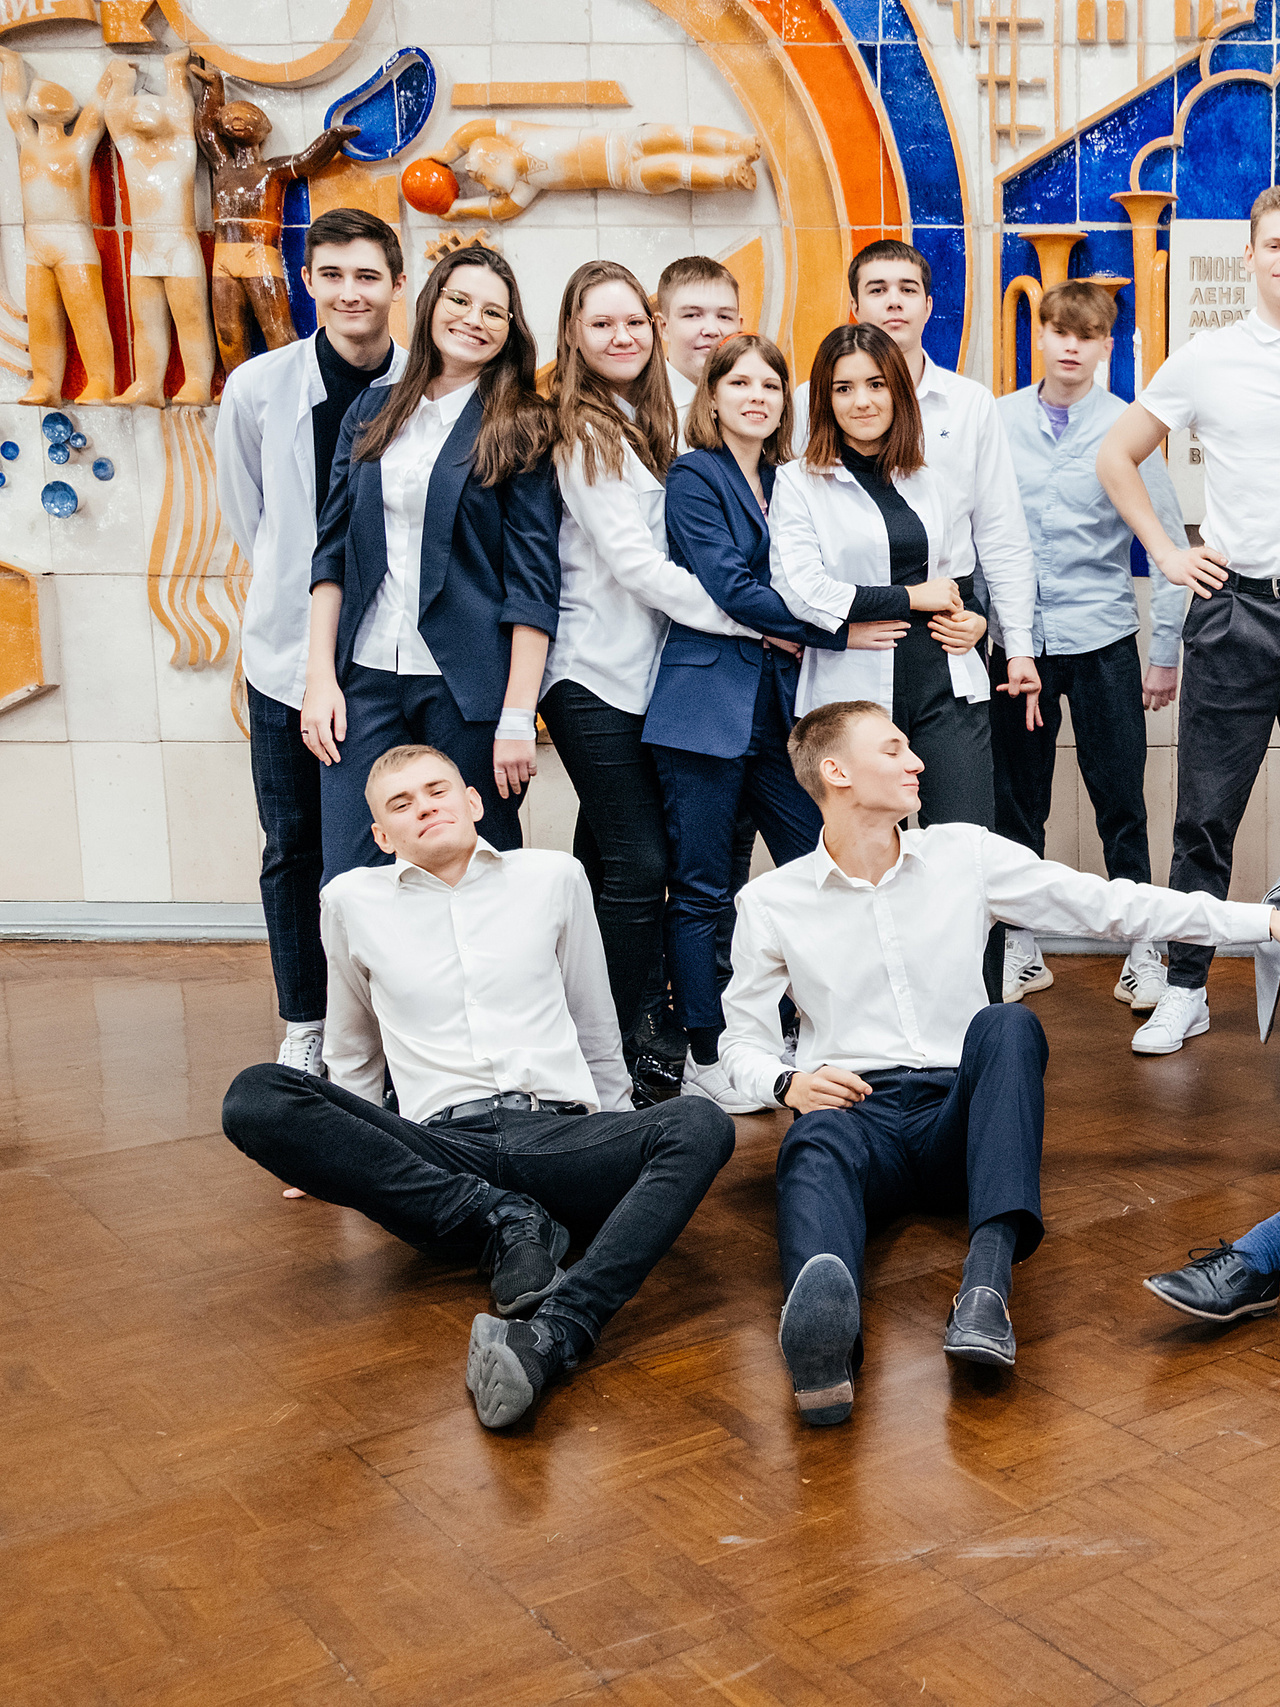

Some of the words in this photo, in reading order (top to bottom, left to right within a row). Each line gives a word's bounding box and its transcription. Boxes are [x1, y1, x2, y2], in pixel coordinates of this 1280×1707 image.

[1189, 256, 1252, 282] ПИОНЕ
[1189, 287, 1246, 305] ЛЕНЯ
[1189, 309, 1251, 328] МАРА
